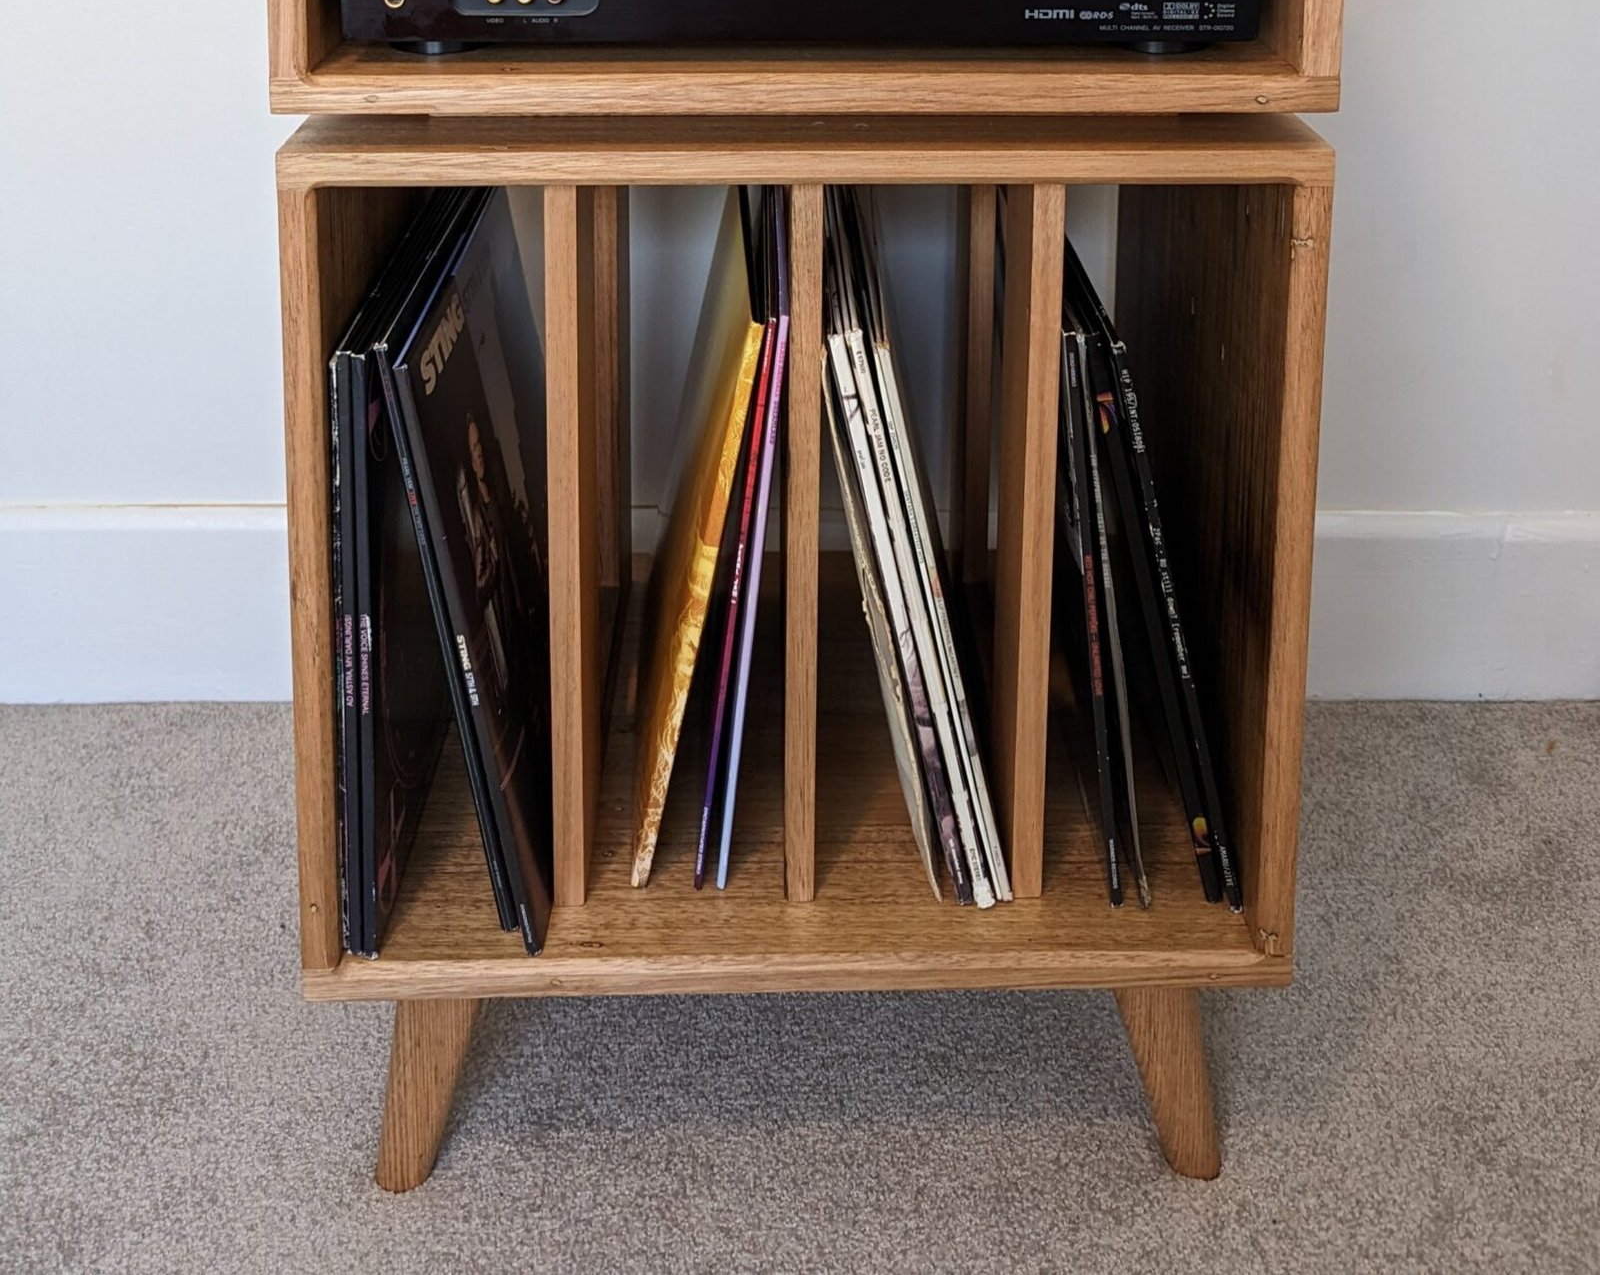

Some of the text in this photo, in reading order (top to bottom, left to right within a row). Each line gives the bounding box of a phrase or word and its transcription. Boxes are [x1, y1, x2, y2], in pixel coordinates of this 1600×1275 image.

[1024, 9, 1075, 19] HDMI
[1131, 3, 1148, 11] dts
[421, 292, 465, 396] STING
[870, 408, 892, 483] PEARL JAM NO CODE
[1085, 555, 1094, 569] RED
[1153, 527, 1162, 546] 2Pac
[1162, 571, 1173, 593] still
[1086, 570, 1095, 585] HOT
[1087, 586, 1097, 603] CHILI
[1088, 604, 1099, 634] PEPPERS
[345, 655, 353, 667] MY
[457, 635, 472, 671] STING
[360, 614, 370, 716] THE VOICE SHINES ETERNAL
[1094, 679, 1104, 696] LOVE
[346, 695, 354, 707] AD
